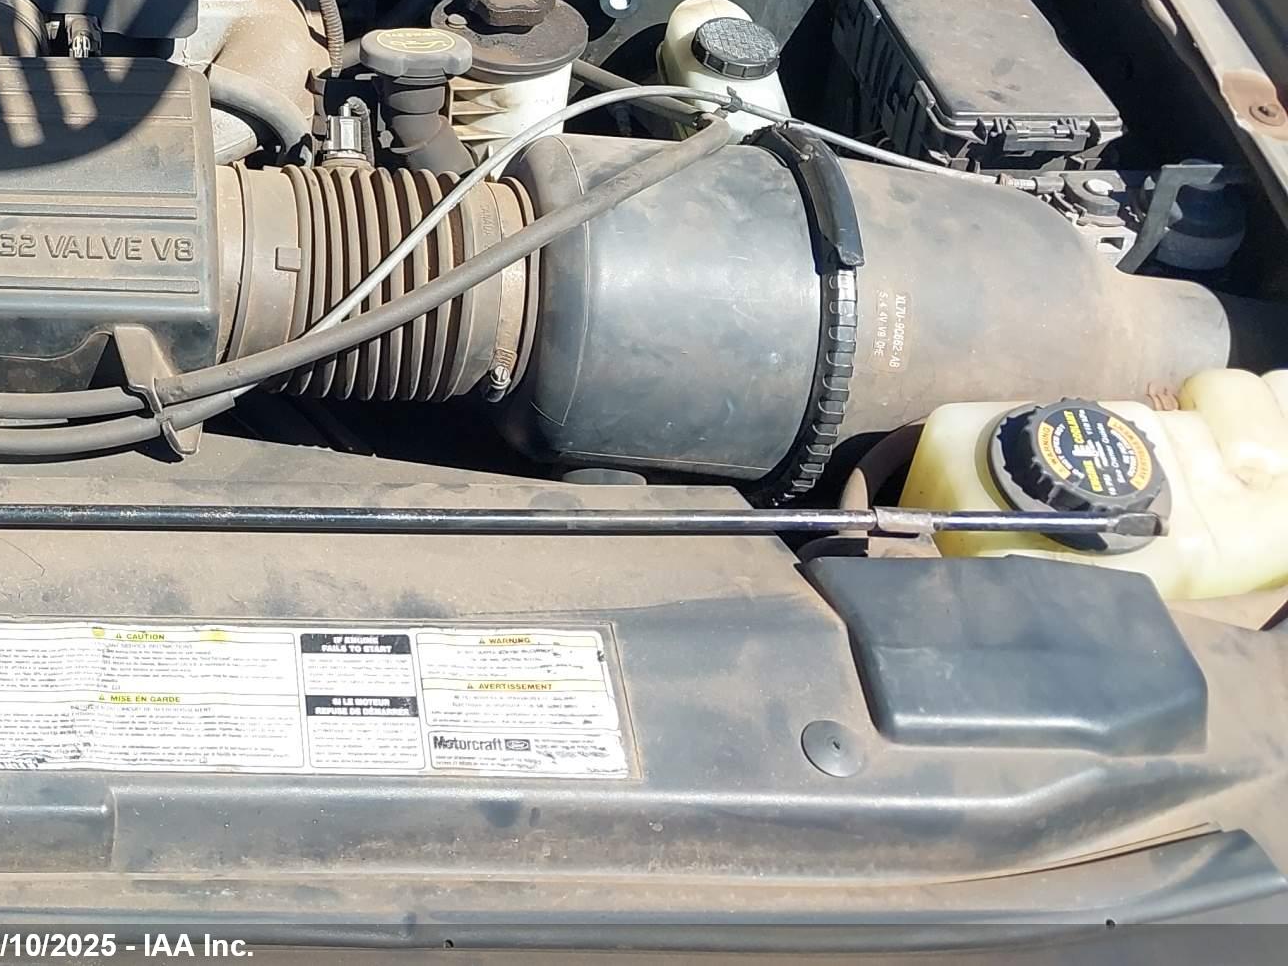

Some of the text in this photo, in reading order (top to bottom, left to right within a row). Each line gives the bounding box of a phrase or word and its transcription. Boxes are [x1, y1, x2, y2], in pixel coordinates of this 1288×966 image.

[0, 234, 36, 258] 32
[44, 235, 143, 261] VALVE
[151, 237, 194, 262] V8
[1064, 410, 1085, 444] COOLANT
[1097, 423, 1110, 444] Guide
[1042, 427, 1057, 465] WARNING
[1106, 445, 1119, 467] Owner
[348, 645, 362, 653] TO
[363, 645, 392, 653] START
[478, 683, 553, 691] AVERTISSEMENT
[433, 735, 503, 751] Motorcraft
